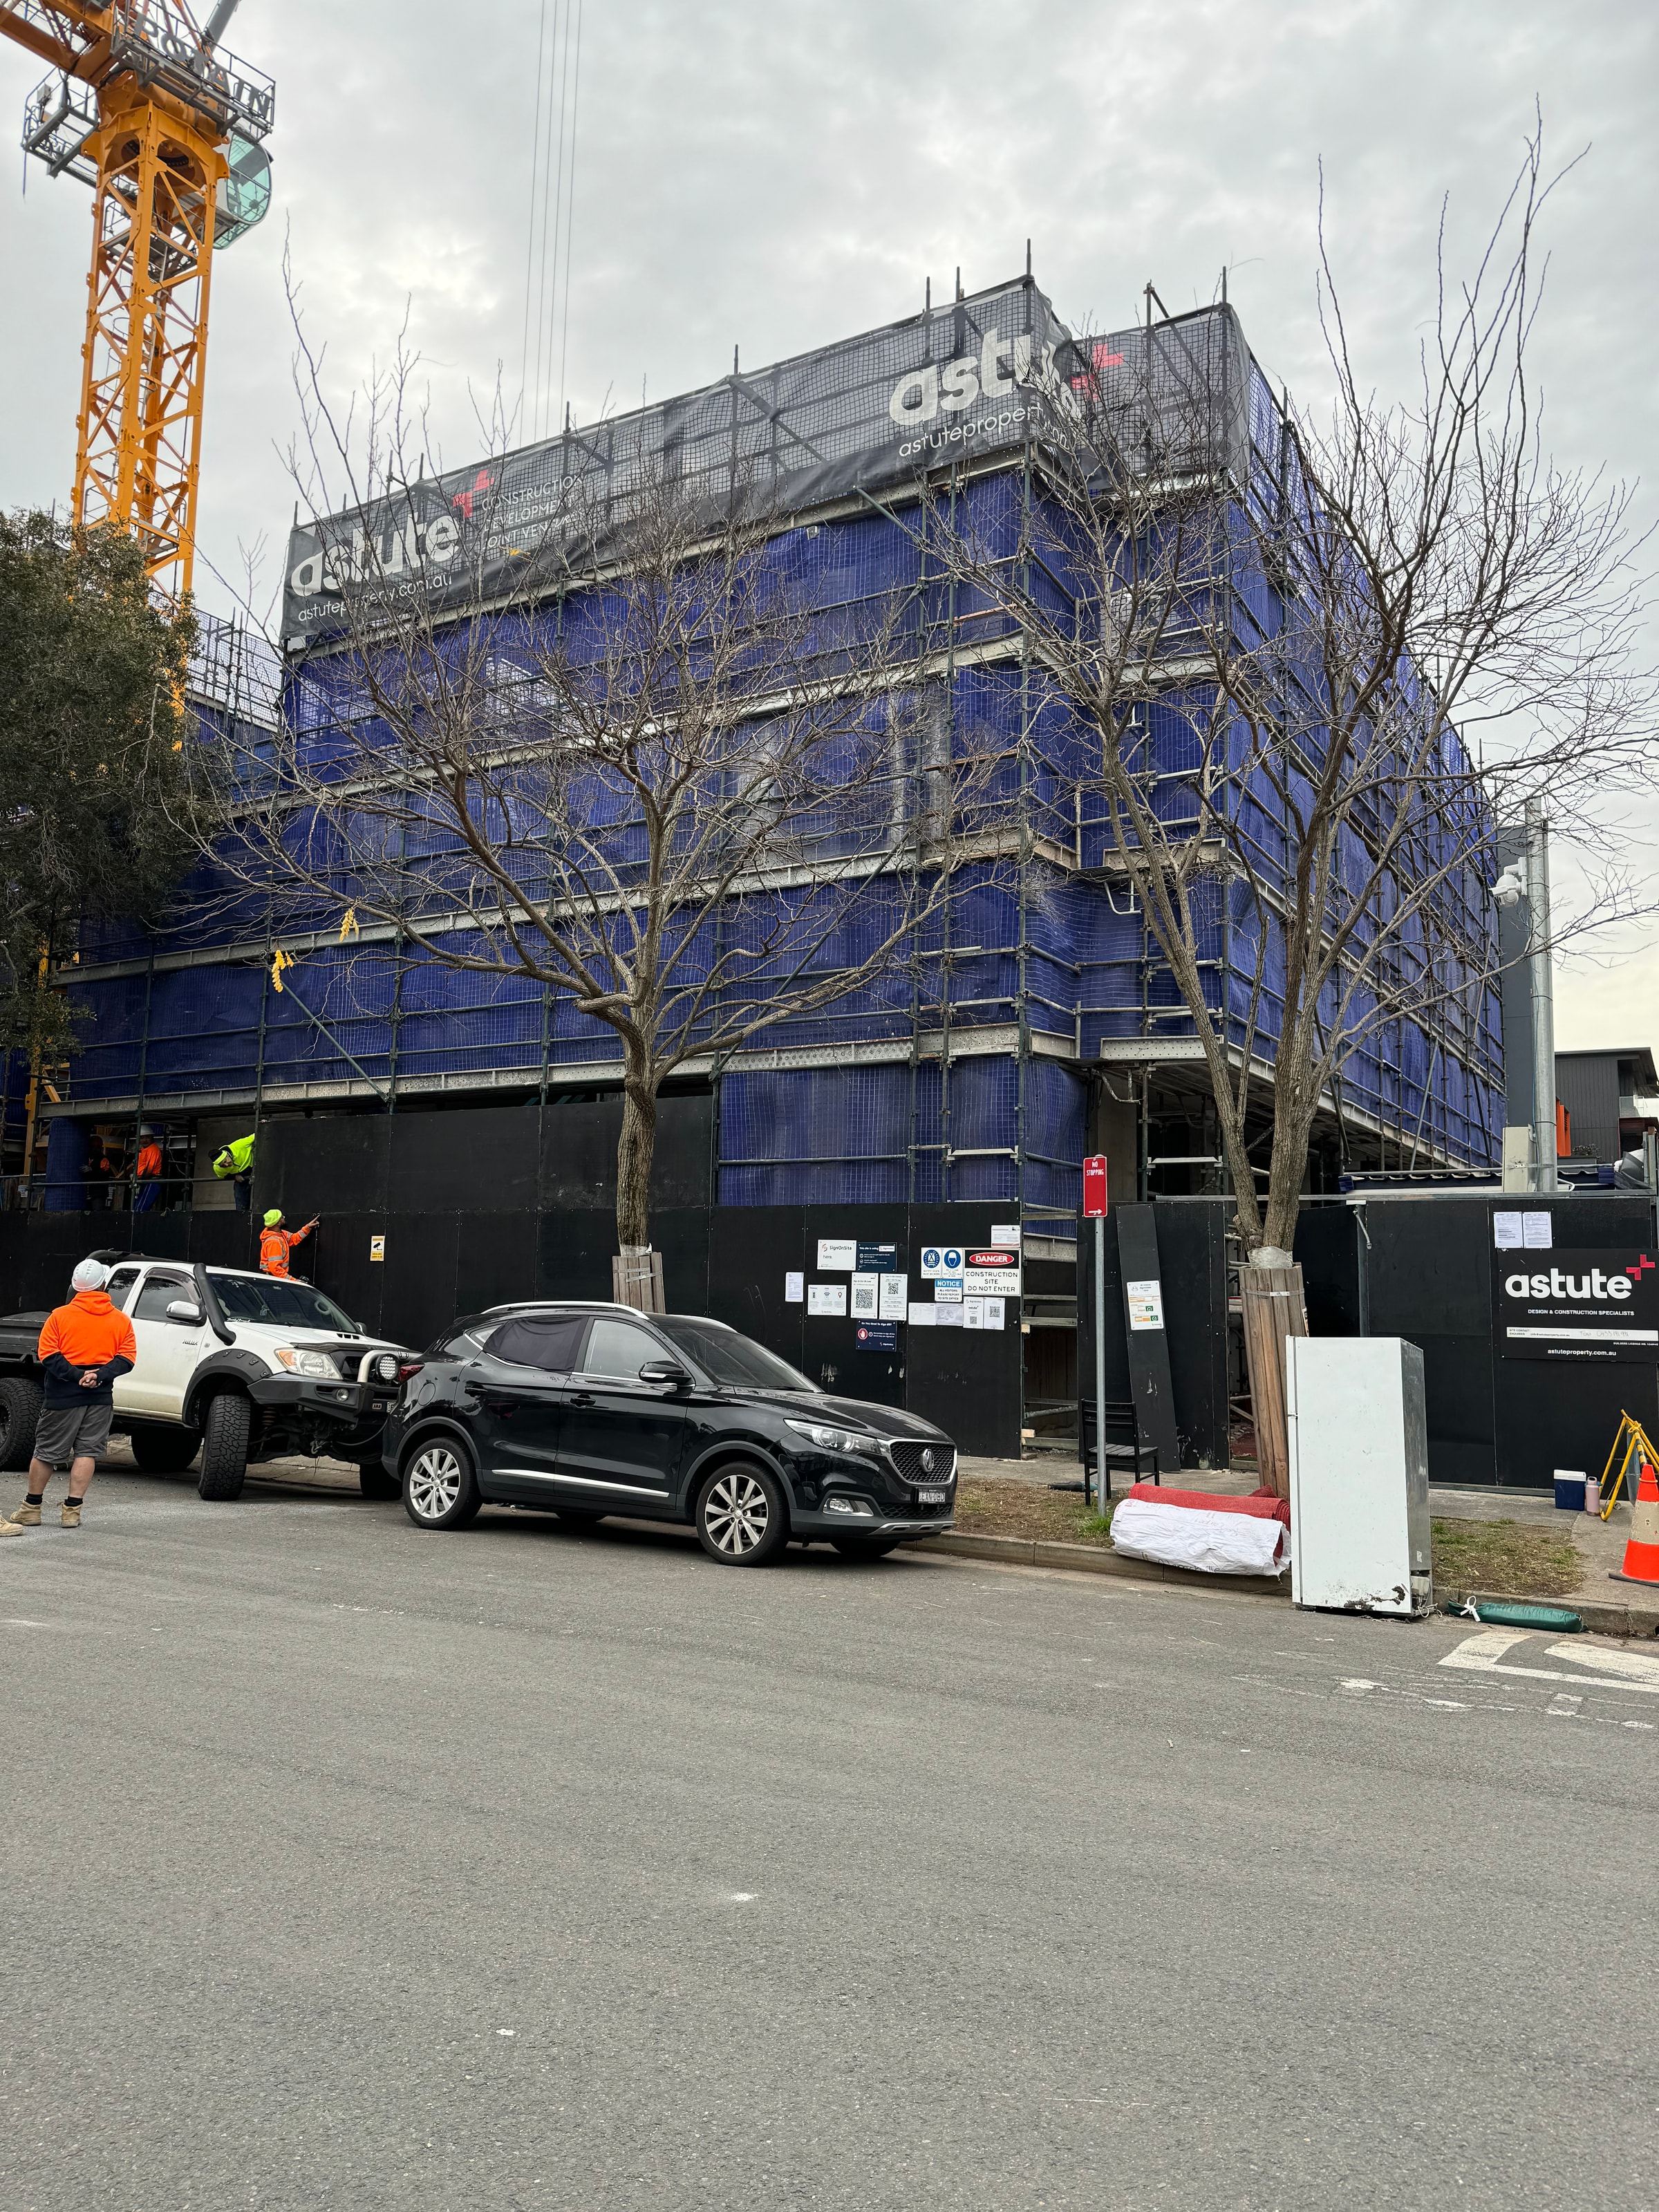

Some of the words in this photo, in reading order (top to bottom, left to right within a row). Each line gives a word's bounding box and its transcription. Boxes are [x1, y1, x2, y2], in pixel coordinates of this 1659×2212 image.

[482, 474, 583, 511] CONSTRUCTION
[291, 513, 460, 597] astute
[975, 1255, 1008, 1263] DANGER
[1505, 1268, 1632, 1300] astute
